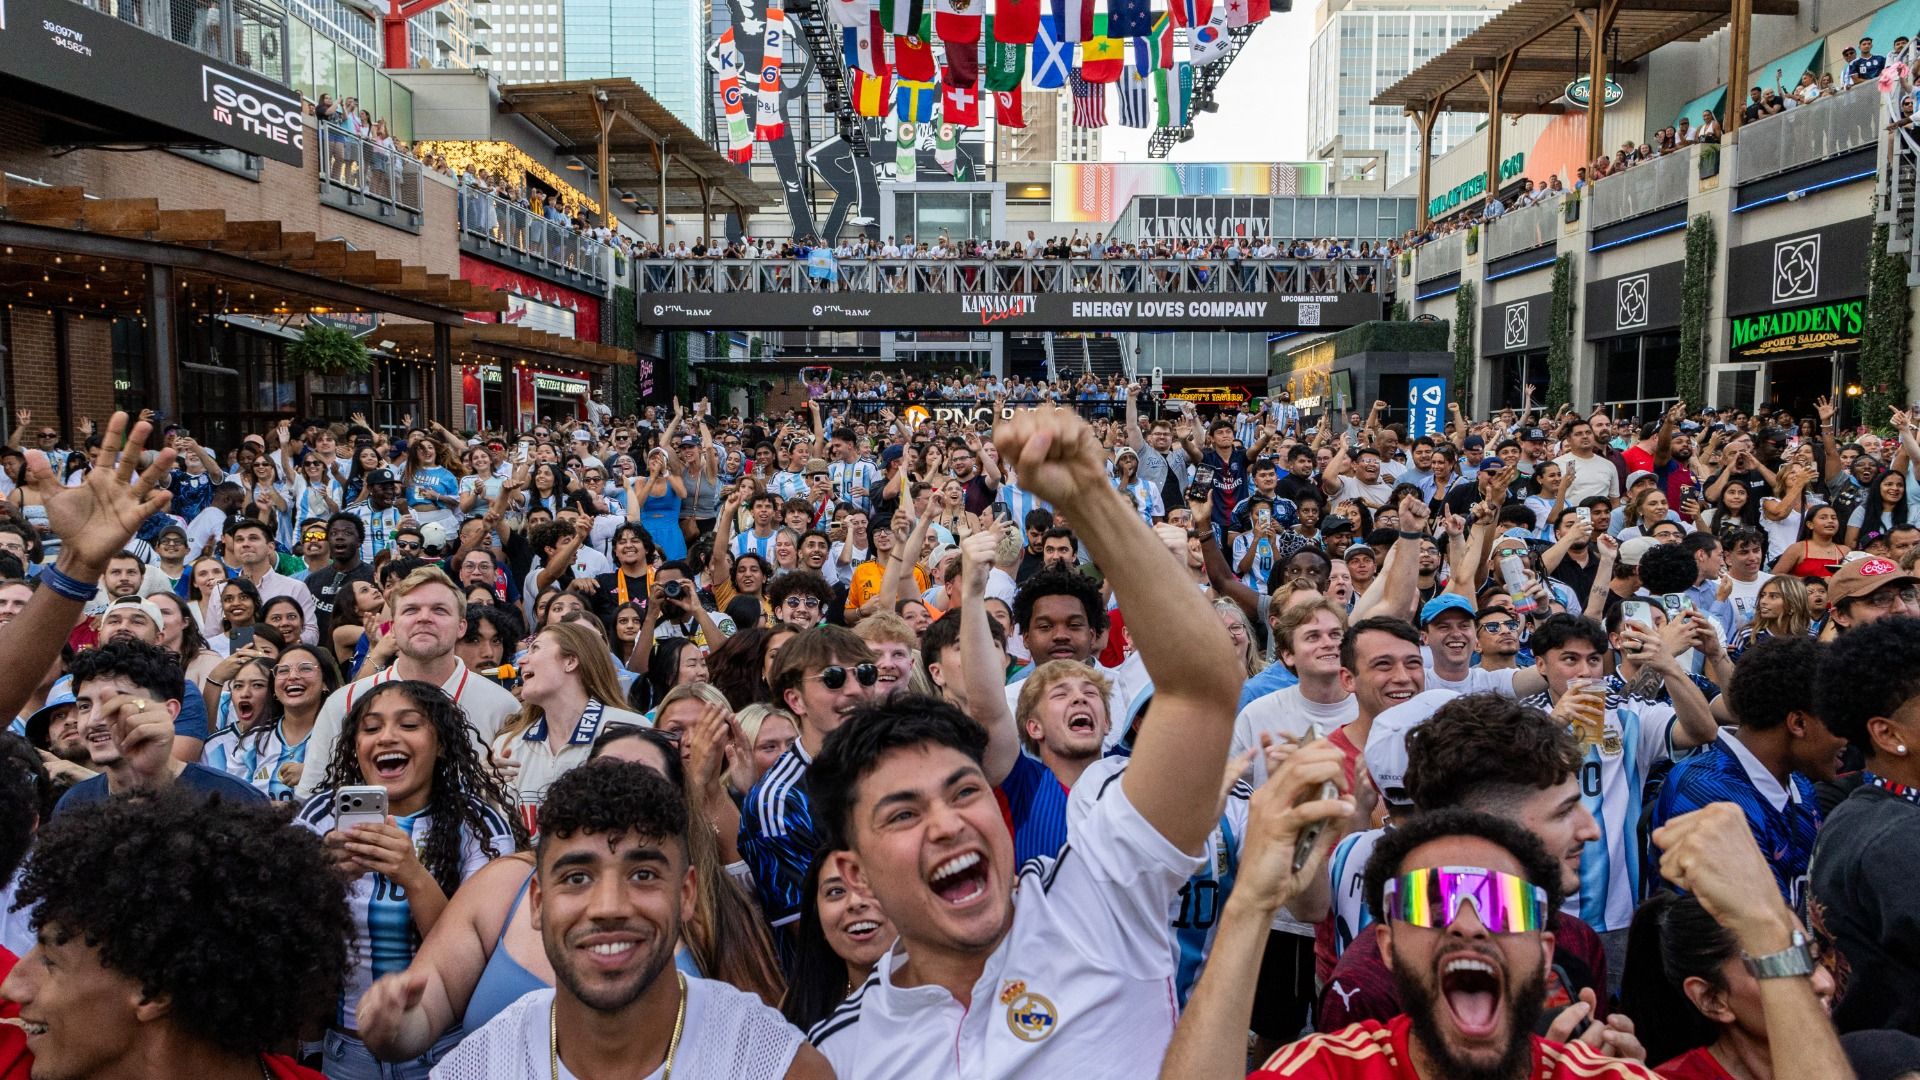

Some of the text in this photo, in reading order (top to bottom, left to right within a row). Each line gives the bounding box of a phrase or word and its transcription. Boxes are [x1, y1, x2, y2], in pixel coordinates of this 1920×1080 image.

[767, 30, 780, 47] 2
[720, 51, 734, 70] K
[762, 66, 777, 83] 6
[725, 87, 741, 105] C
[1604, 87, 1621, 98] Bar
[213, 106, 232, 126] IN
[237, 112, 288, 145] THE
[899, 123, 914, 141] C
[939, 122, 953, 142] 6
[1140, 217, 1269, 246] KANSAS CITY
[962, 295, 1038, 313] KANSAS CITY
[1281, 295, 1339, 303] UPCOMING EVENTS
[981, 299, 1025, 325] Live!
[1072, 301, 1268, 318] ENERGY LOVES COMPANY
[1731, 300, 1863, 349] McFADDEN'S
[1762, 332, 1838, 349] SPORTS SALOON
[488, 370, 502, 382] DRI
[933, 407, 993, 427] PNC
[1213, 477, 1244, 491] Emirates
[1259, 556, 1272, 571] 10
[1864, 563, 1893, 575] Coors
[575, 711, 602, 742] FIFA
[1171, 880, 1220, 929] 10
